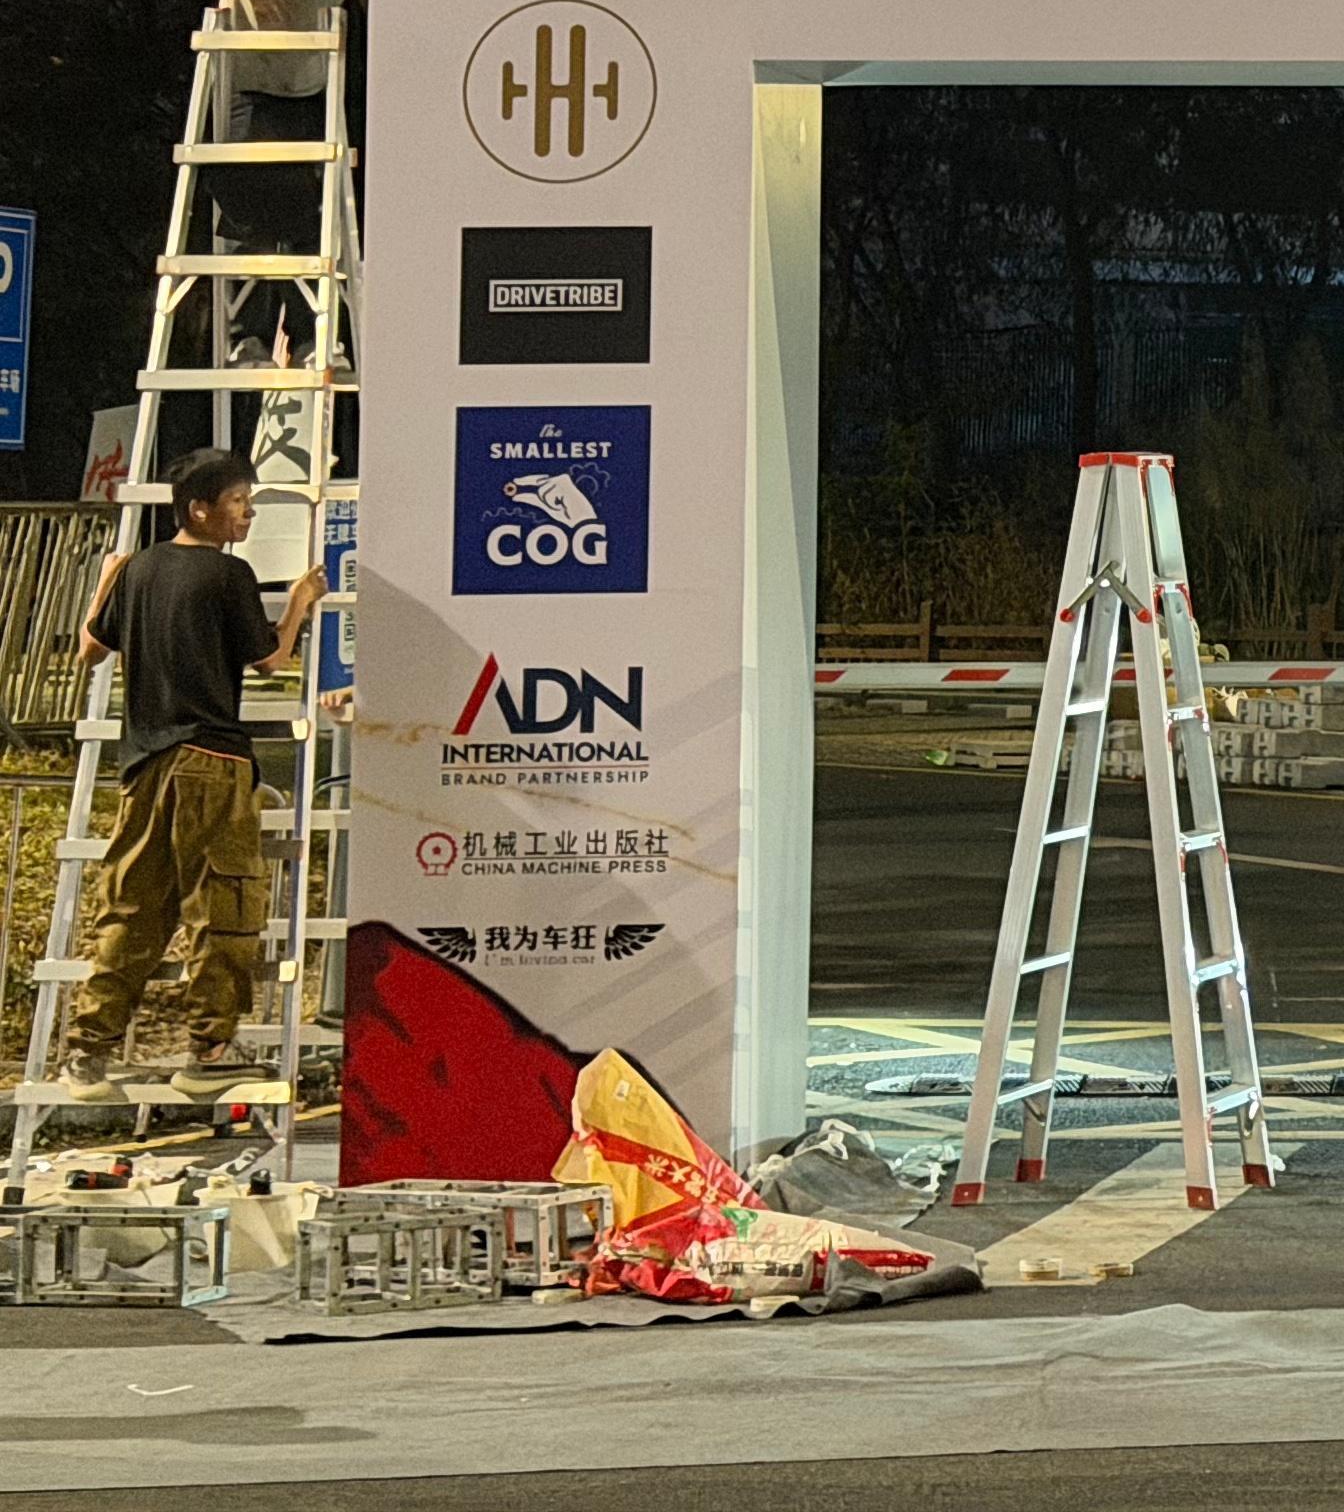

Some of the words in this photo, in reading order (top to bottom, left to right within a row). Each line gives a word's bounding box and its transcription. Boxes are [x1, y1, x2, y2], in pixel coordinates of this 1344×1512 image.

[496, 285, 617, 306] DRIVETRIBE
[539, 424, 563, 437] The
[490, 442, 611, 459] SMALLEST
[487, 524, 607, 566] COG
[451, 653, 643, 736] ADN
[442, 741, 649, 764] INTERNATIONAL
[442, 772, 507, 786] BRAND
[518, 770, 649, 784] PARTNERSHIP
[463, 830, 669, 856] 机械工业出版社
[462, 860, 515, 875] CHINA
[522, 860, 601, 874] MACHINE
[608, 859, 666, 873] PRESS
[485, 925, 596, 951] 我为车狂
